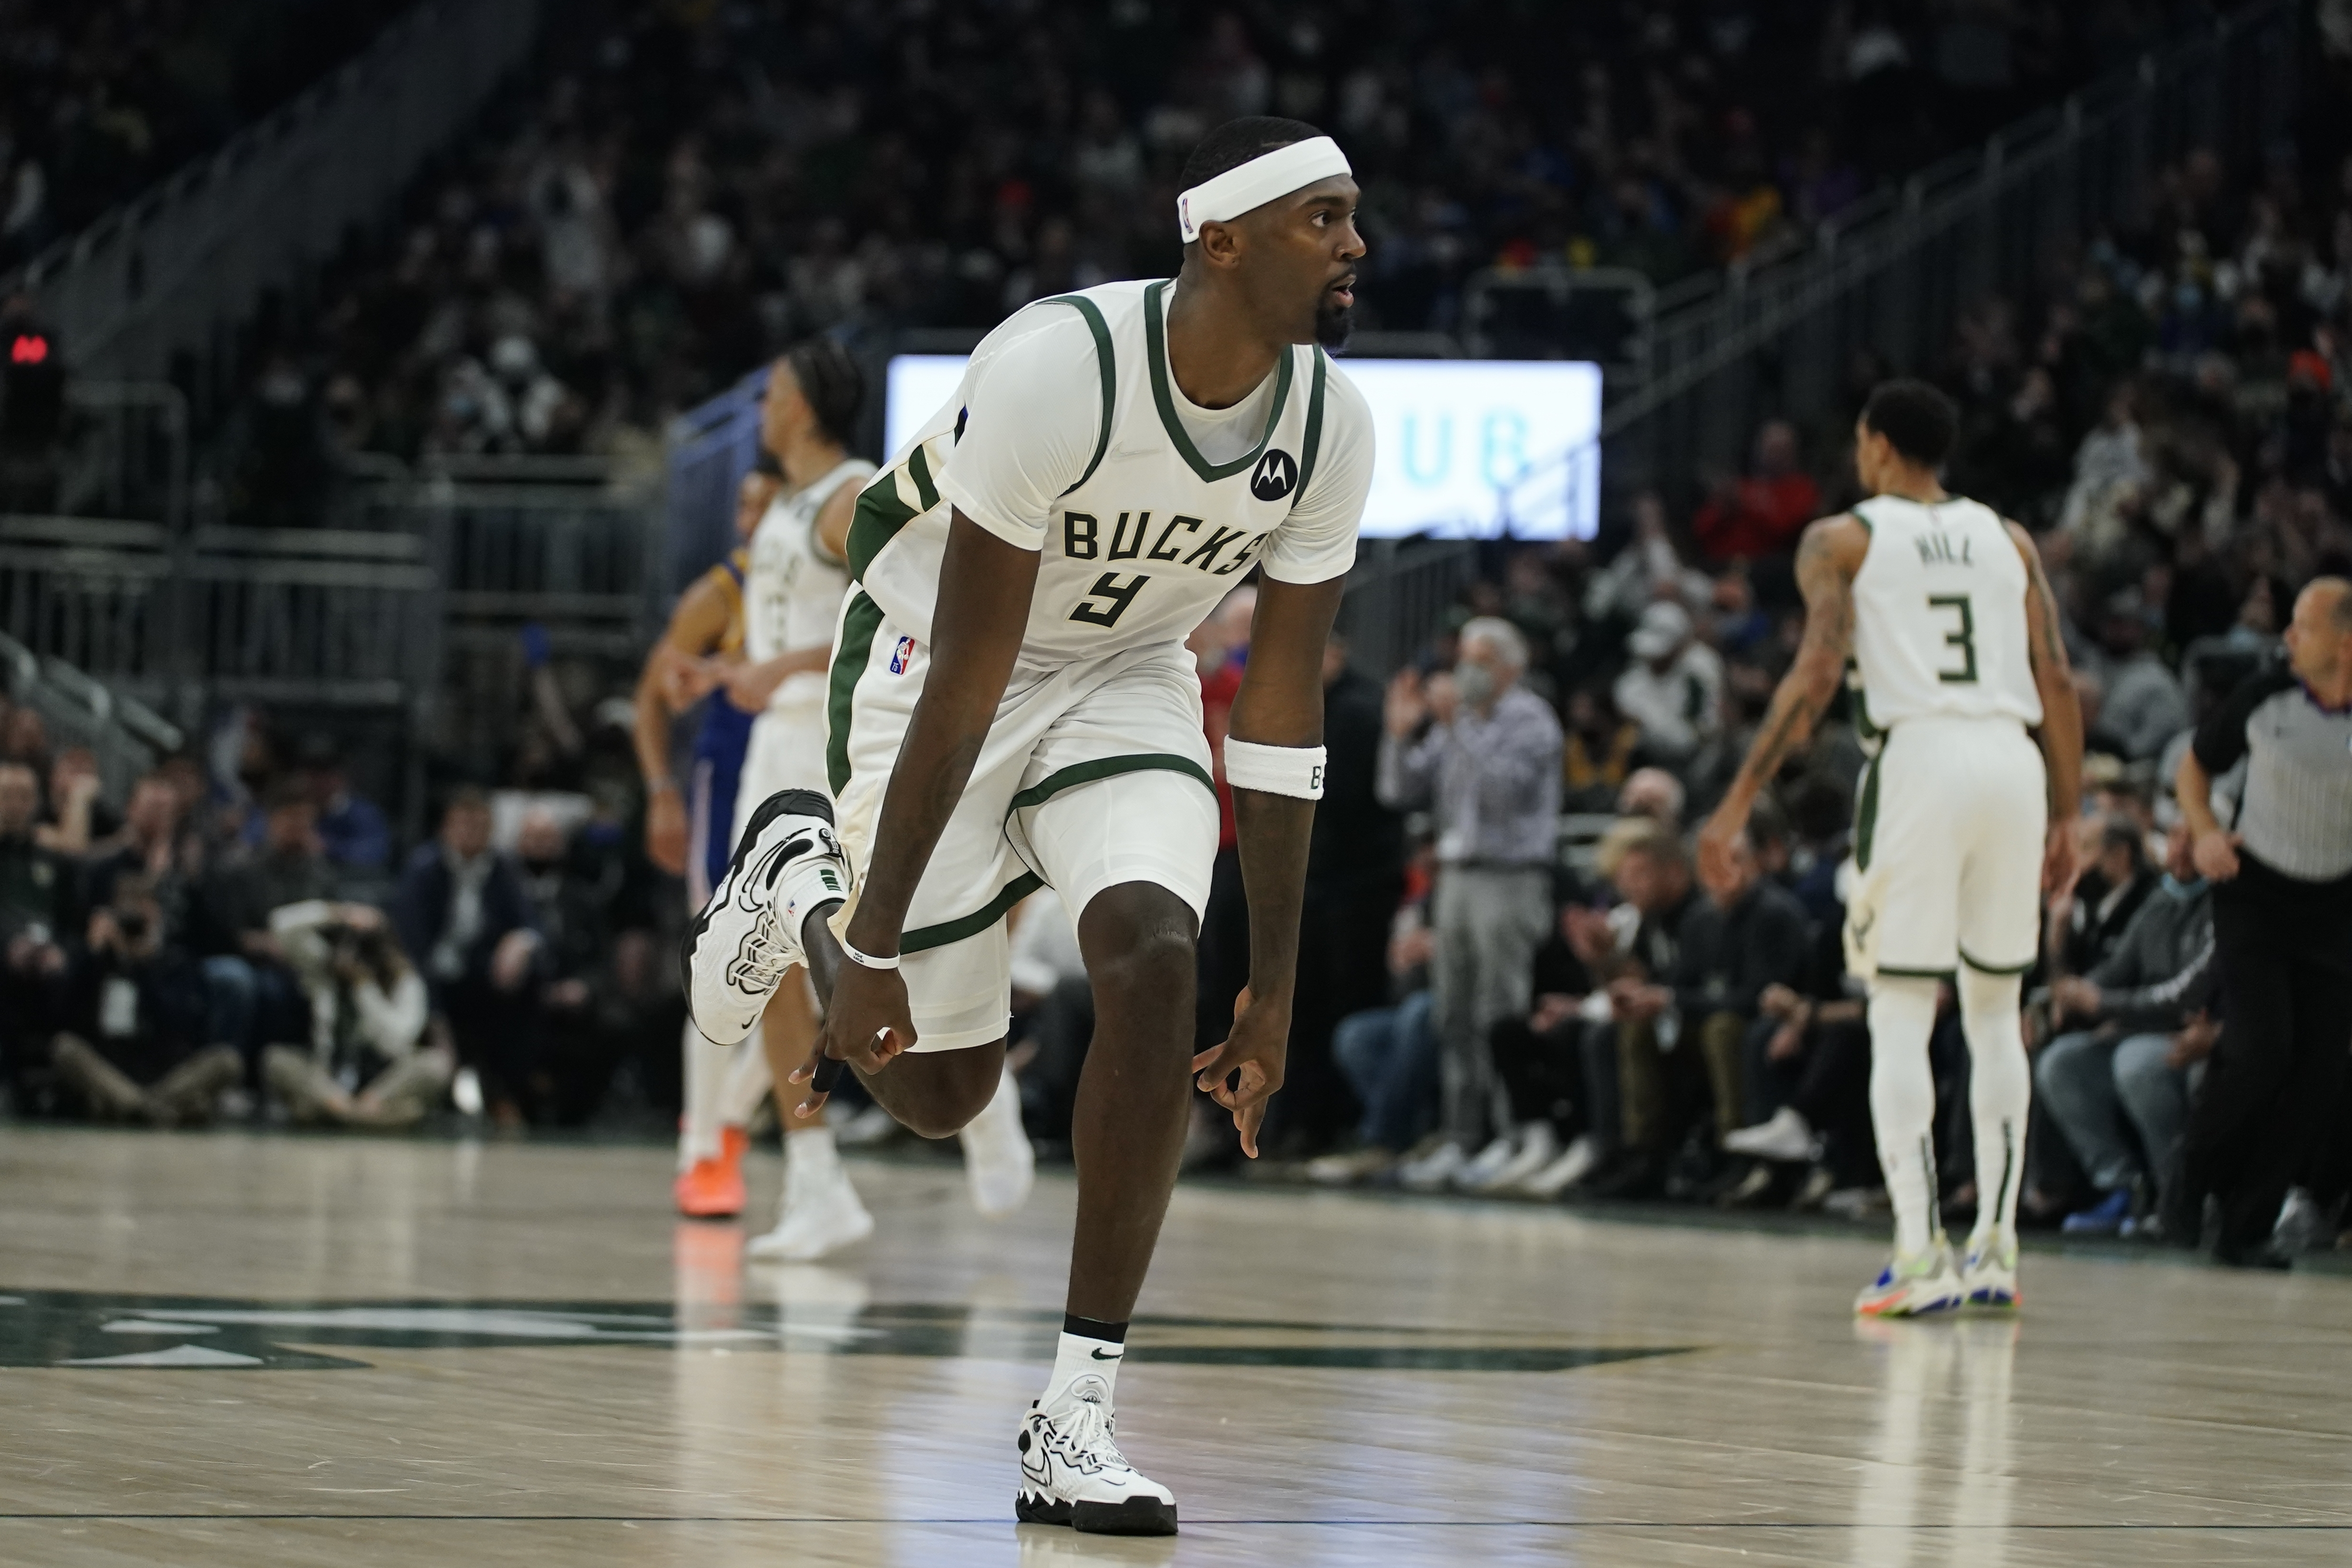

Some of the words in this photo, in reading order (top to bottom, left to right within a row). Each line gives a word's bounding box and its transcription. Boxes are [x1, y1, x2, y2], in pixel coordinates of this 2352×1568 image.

[1063, 510, 1269, 575] BUCKS
[1914, 531, 1973, 567] HILL
[1066, 571, 1151, 629] 9
[1928, 594, 1978, 683] 3
